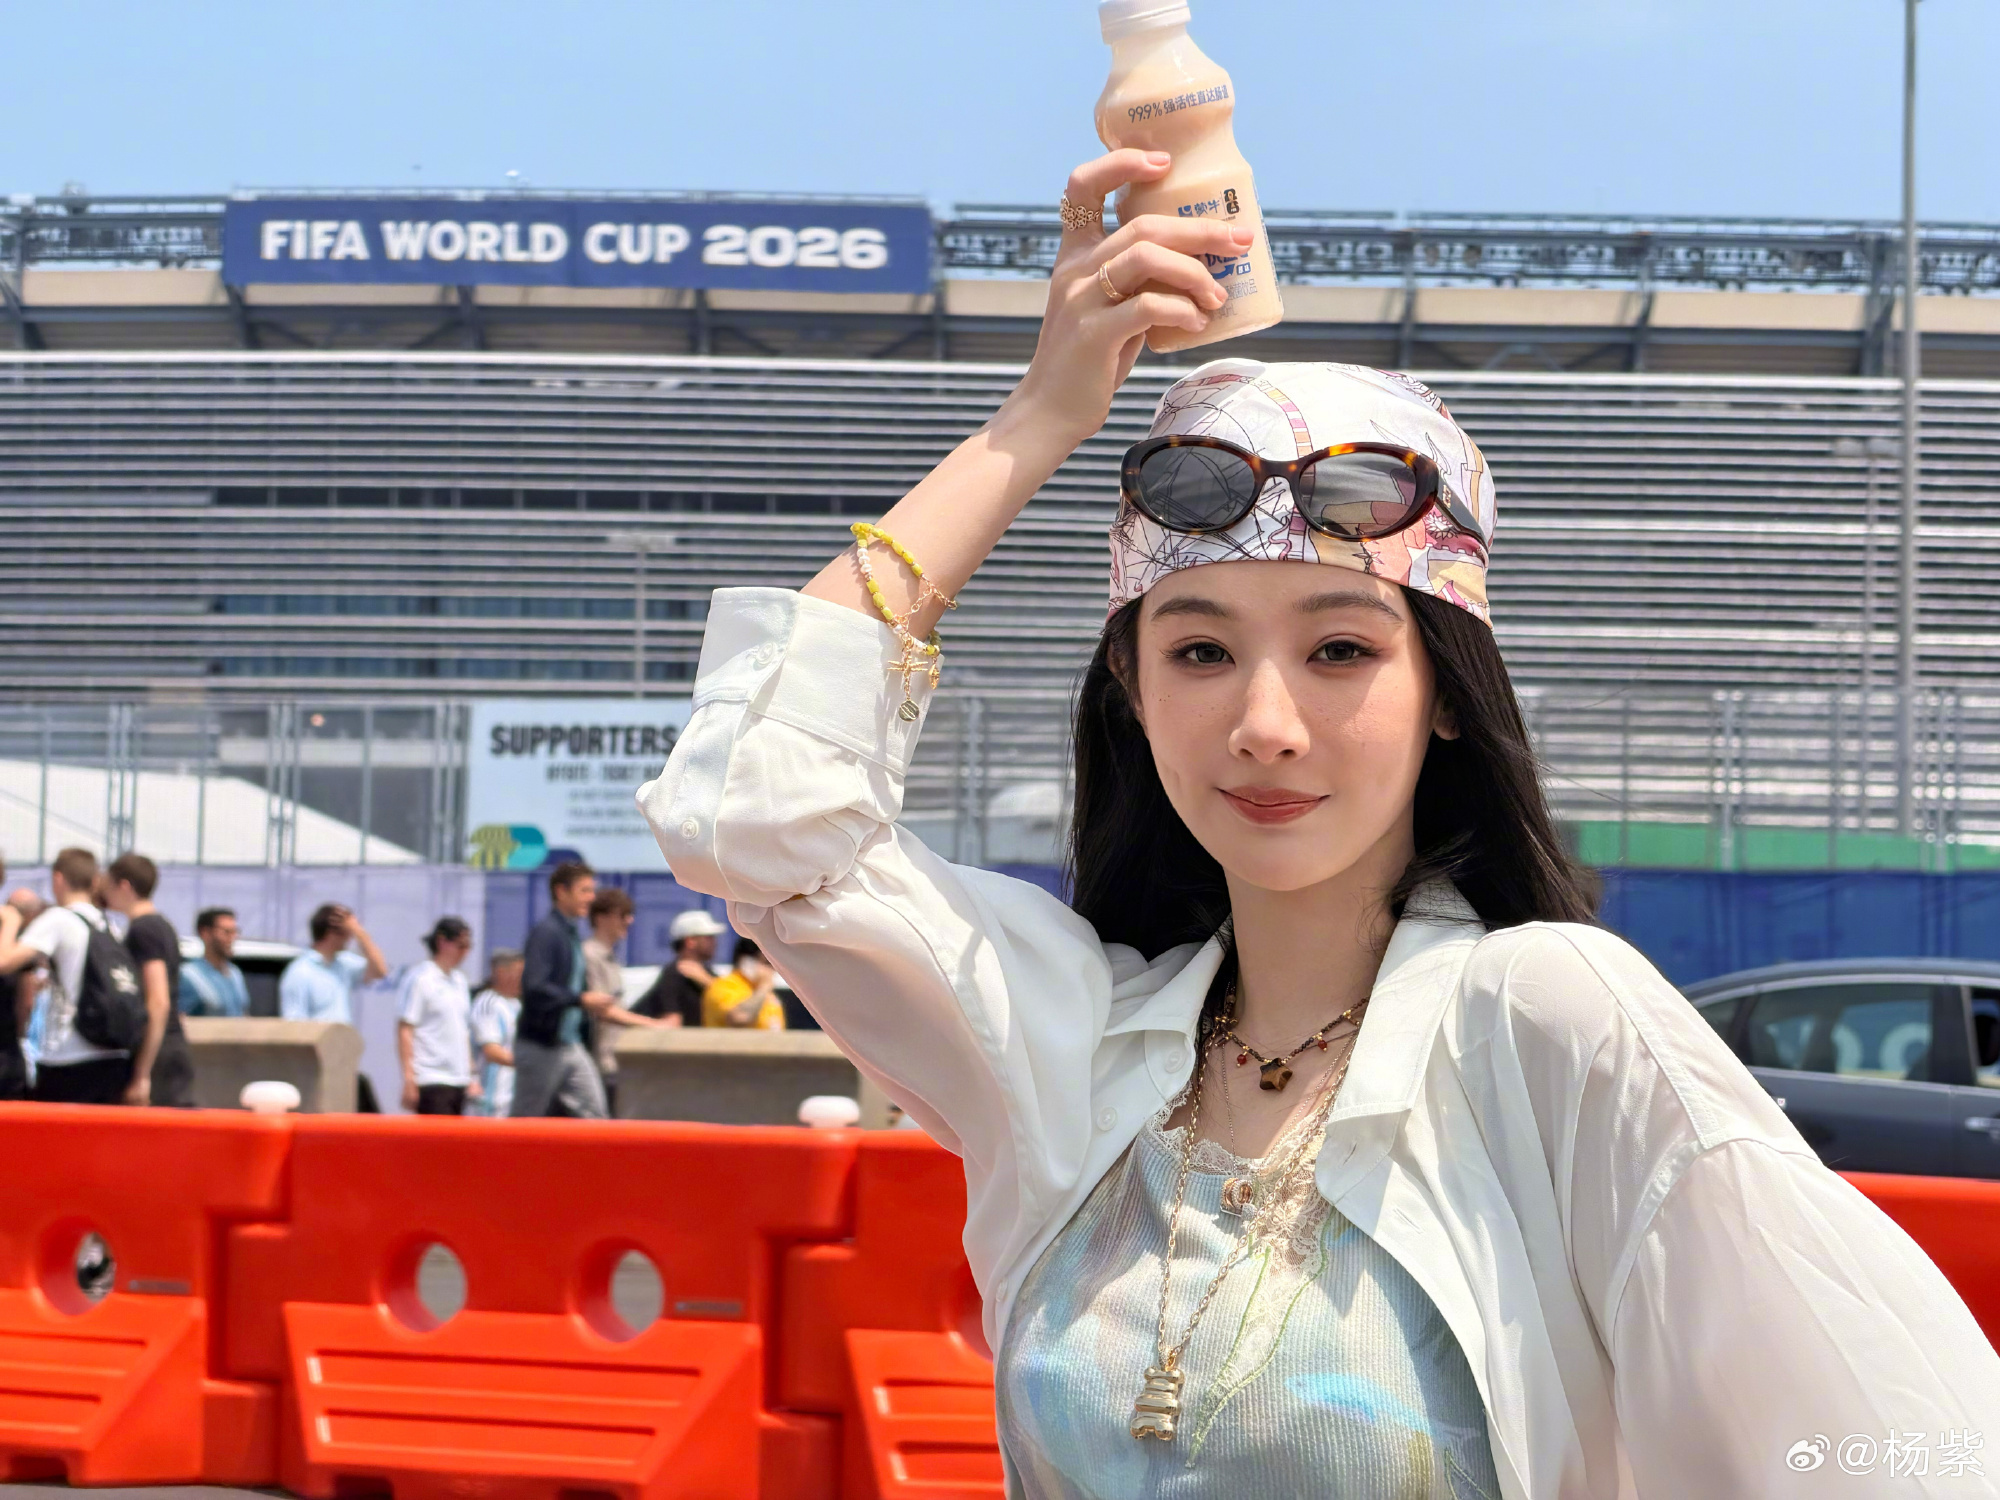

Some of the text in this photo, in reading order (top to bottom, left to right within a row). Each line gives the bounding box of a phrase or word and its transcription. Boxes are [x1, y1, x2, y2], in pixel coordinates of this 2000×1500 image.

[260, 219, 888, 269] FIFA WORLD CUP 2026
[490, 725, 678, 756] SUPPORTERS
